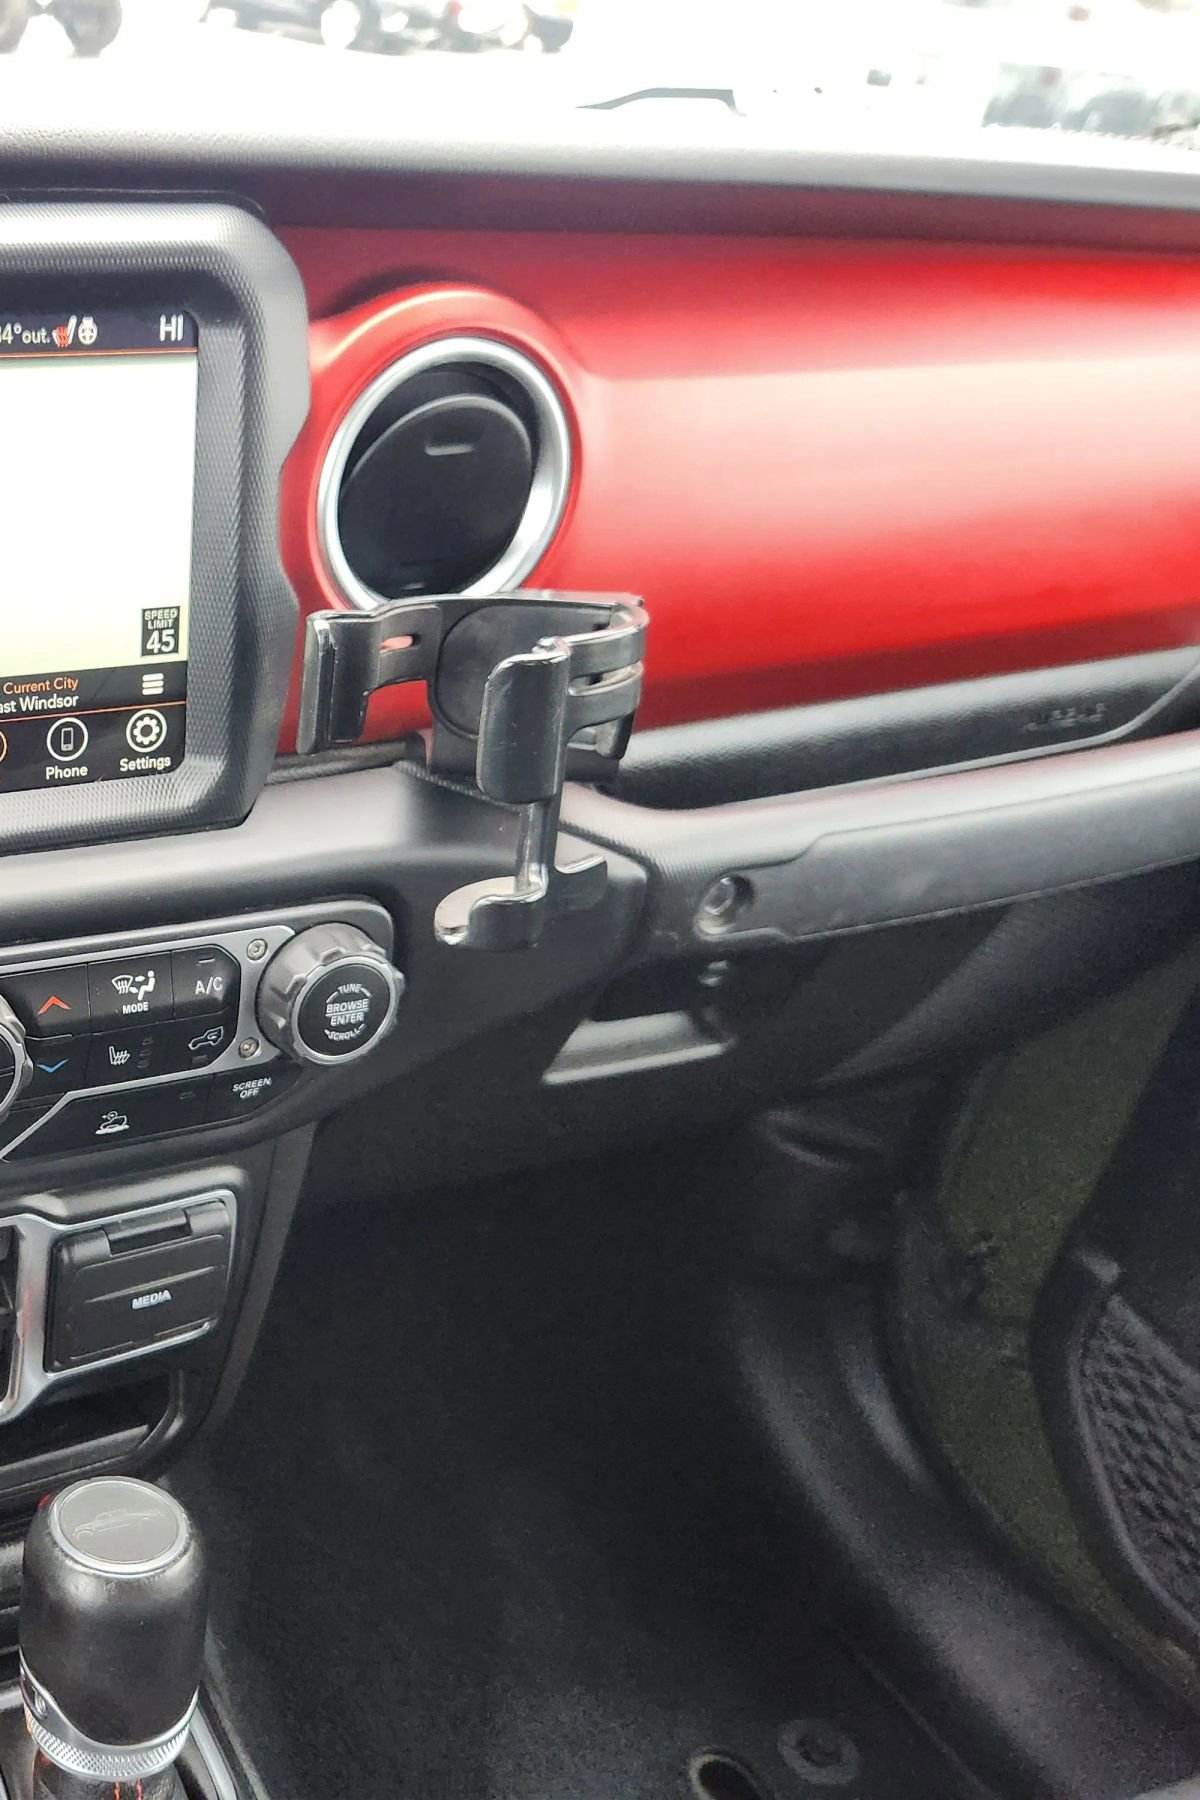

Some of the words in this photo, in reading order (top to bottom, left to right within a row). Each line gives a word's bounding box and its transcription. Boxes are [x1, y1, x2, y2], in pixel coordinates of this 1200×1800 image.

[159, 314, 184, 342] HI
[144, 608, 178, 621] SPEED
[147, 618, 174, 630] LIMIT
[146, 629, 175, 654] 45
[3, 680, 51, 695] Current
[54, 677, 79, 692] City
[19, 694, 79, 713] Windsor
[119, 755, 171, 772] Settings
[45, 765, 88, 780] Phone
[195, 975, 223, 996] A/C
[337, 983, 361, 995] TUNE
[122, 1002, 149, 1015] MODE
[325, 998, 369, 1014] BROWSE
[330, 1012, 364, 1026] ENTER
[328, 1027, 360, 1041] SCROLL
[232, 1077, 272, 1093] SCREEN
[239, 1087, 259, 1099] OFF
[132, 1289, 172, 1309] MEDIA
